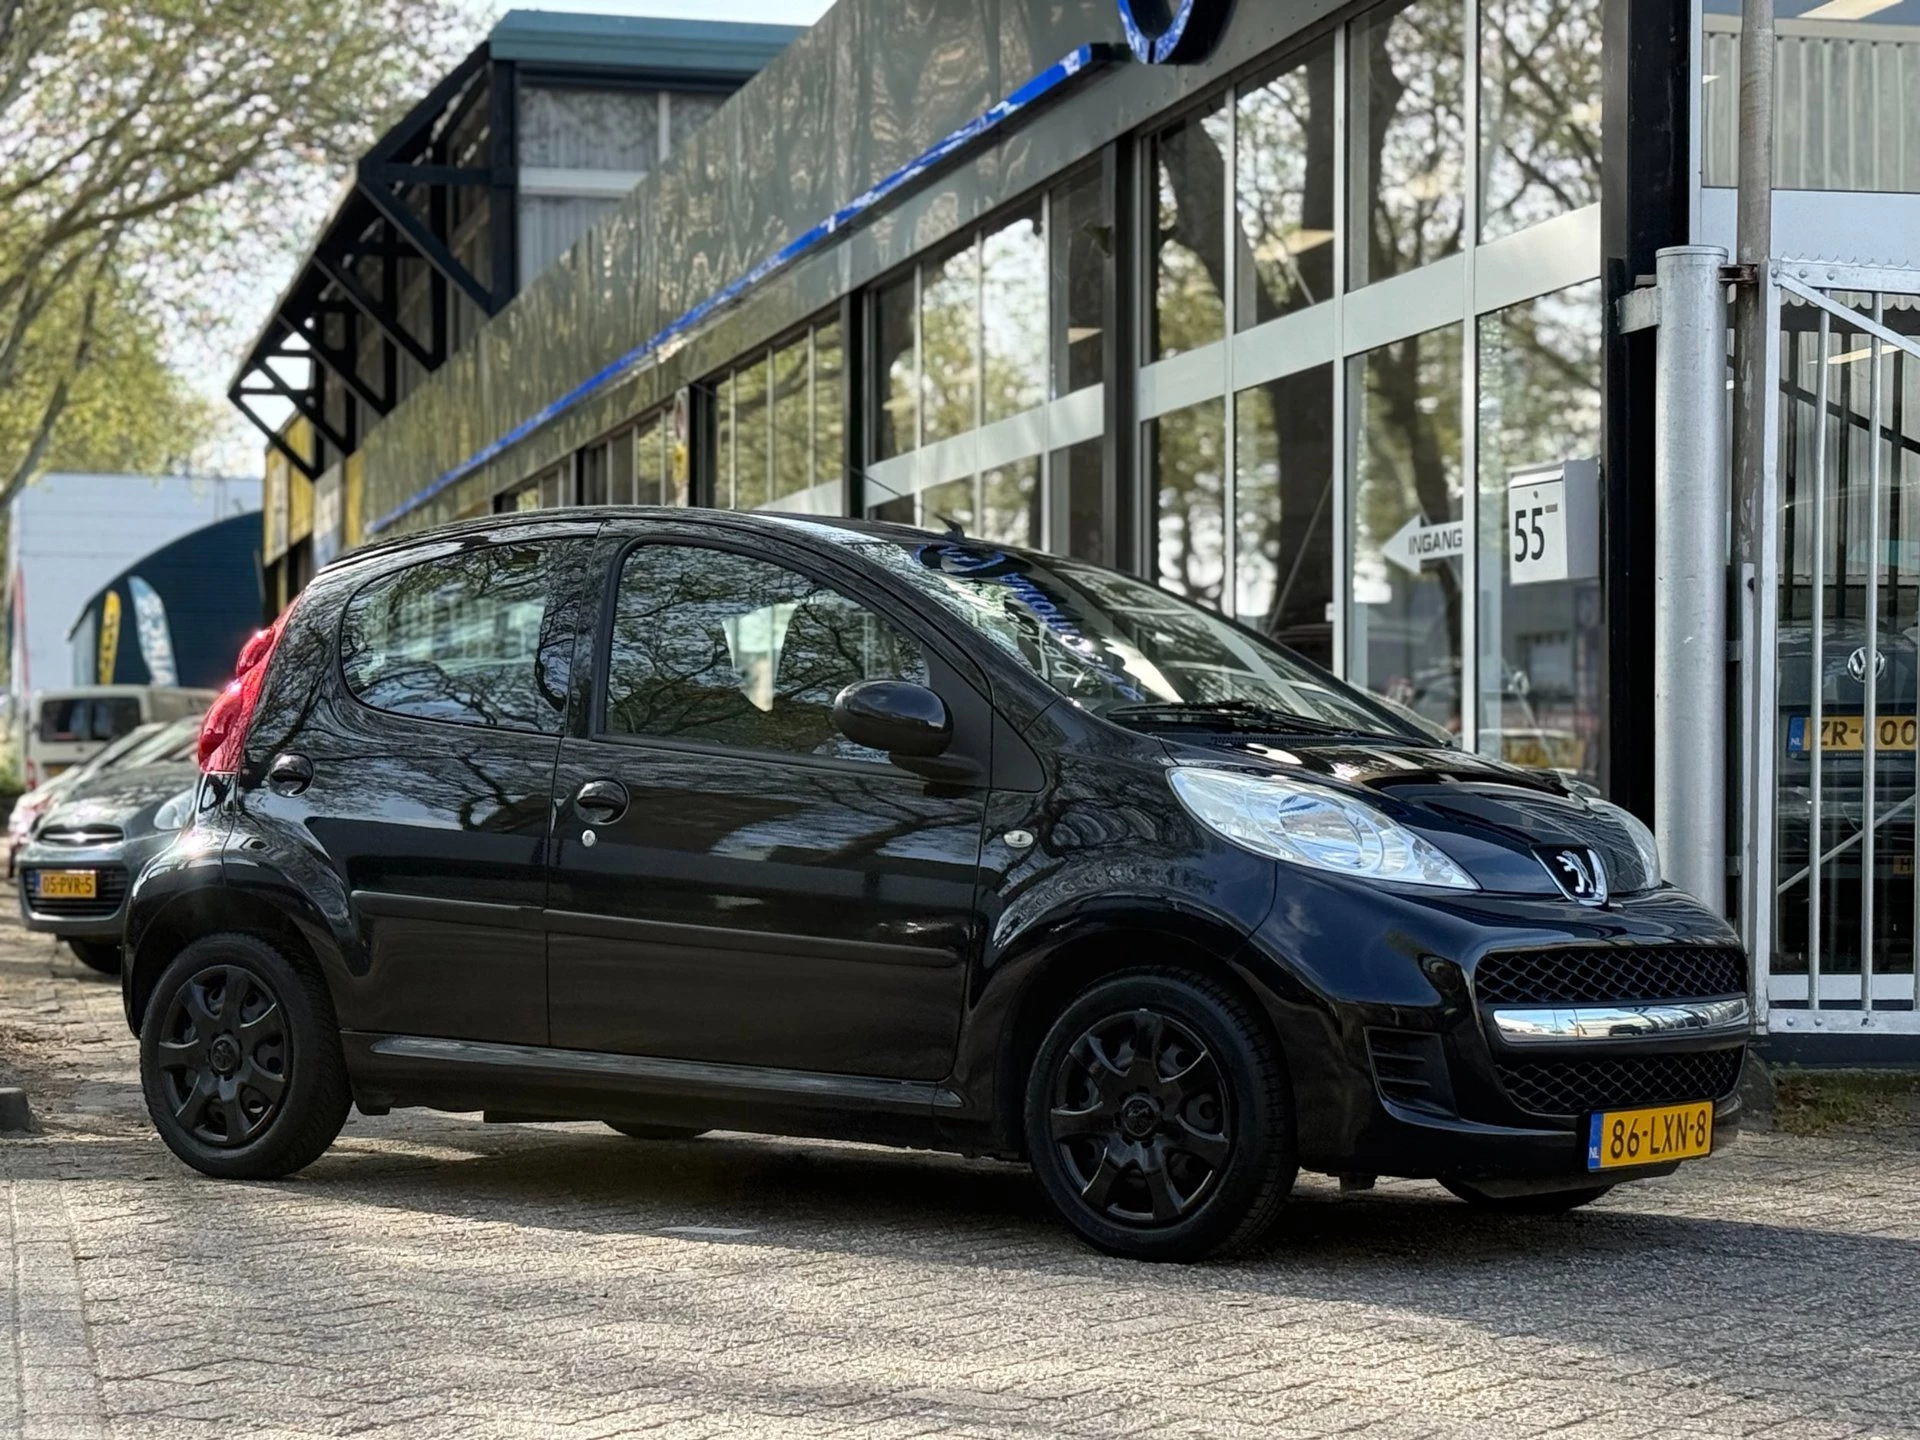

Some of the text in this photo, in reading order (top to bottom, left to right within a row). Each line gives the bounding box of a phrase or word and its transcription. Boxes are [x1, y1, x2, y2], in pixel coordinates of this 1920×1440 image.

[1408, 528, 1463, 556] INGANG
[1514, 507, 1545, 563] 55
[1588, 1109, 1706, 1160] NL 86-LXN-8
